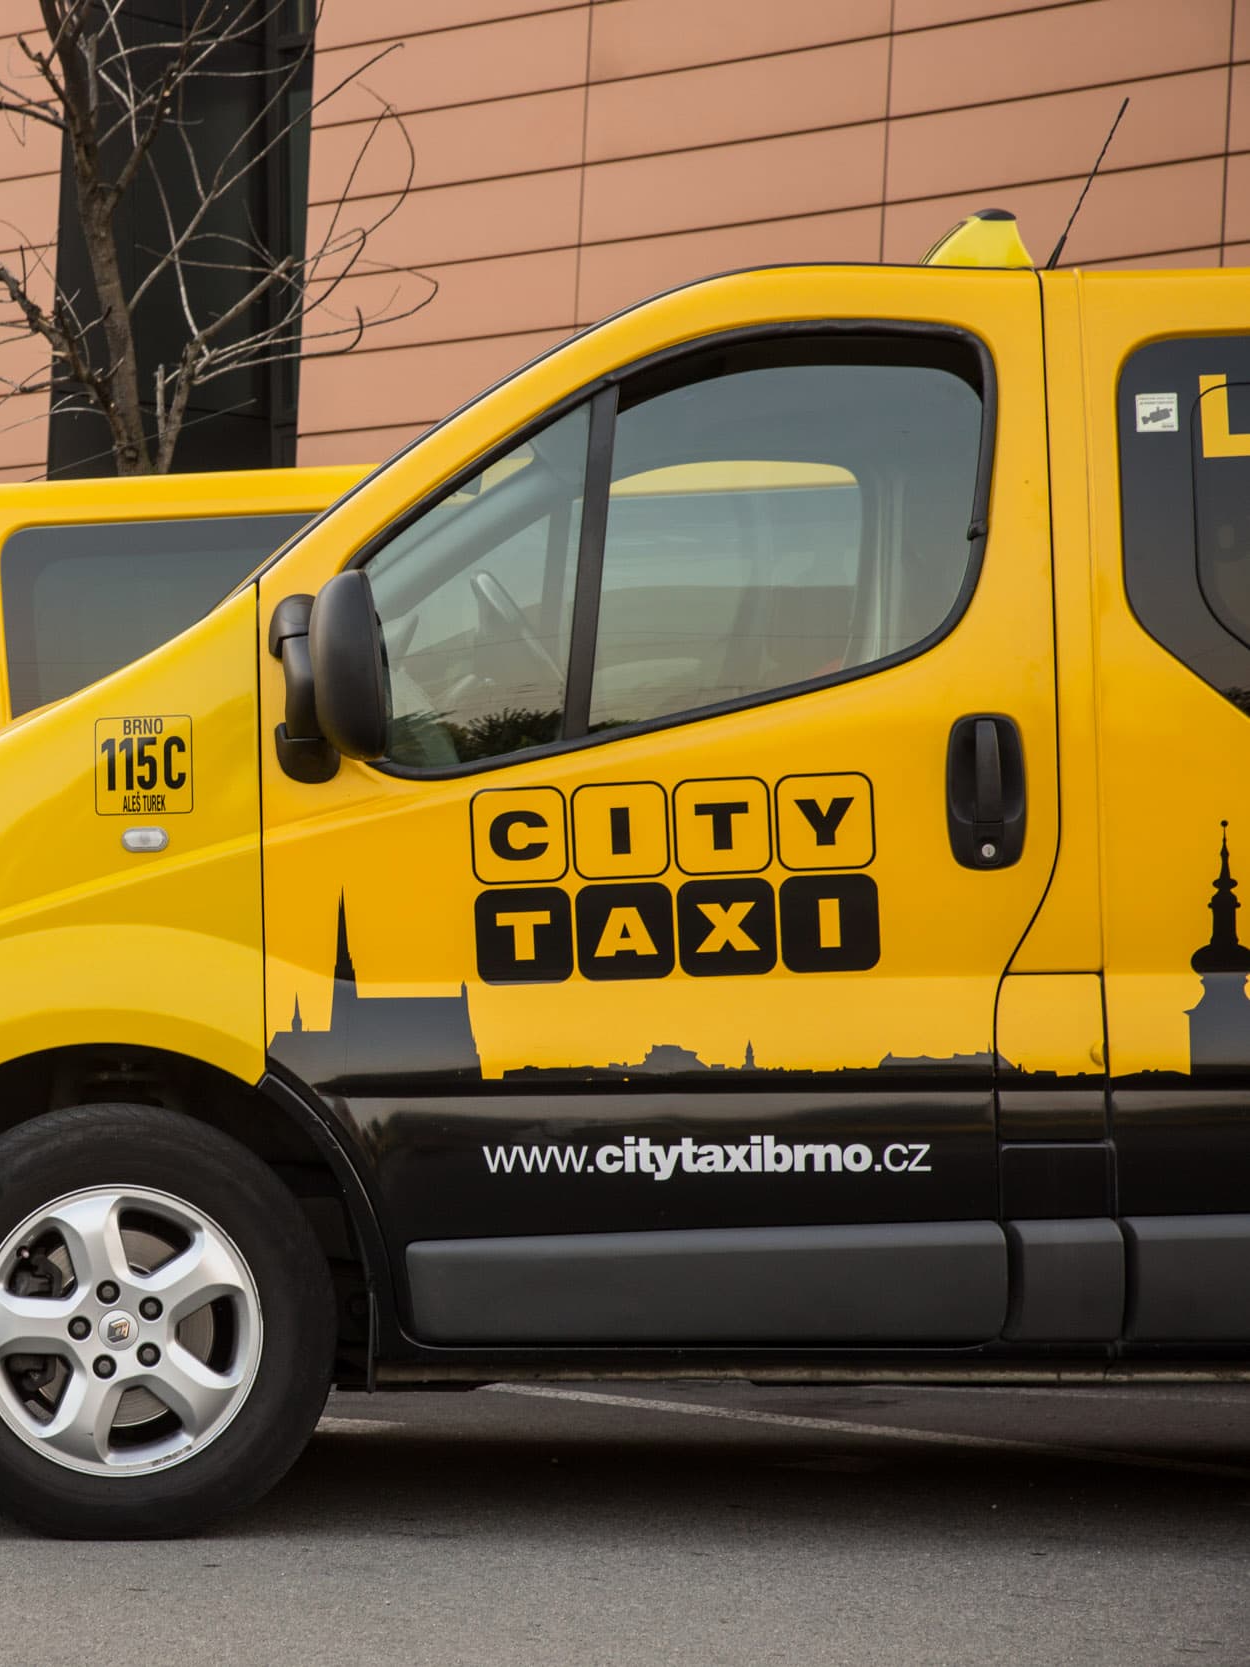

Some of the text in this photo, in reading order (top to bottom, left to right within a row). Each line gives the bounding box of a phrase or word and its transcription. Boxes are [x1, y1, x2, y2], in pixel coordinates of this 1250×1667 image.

[123, 718, 163, 735] BRNO
[101, 736, 187, 791] 115C
[123, 792, 166, 812] ALEŠ TUREK
[488, 796, 855, 861] CITY
[495, 897, 842, 961] TAXI
[482, 1136, 932, 1181] www.citytaxibrno.cz
